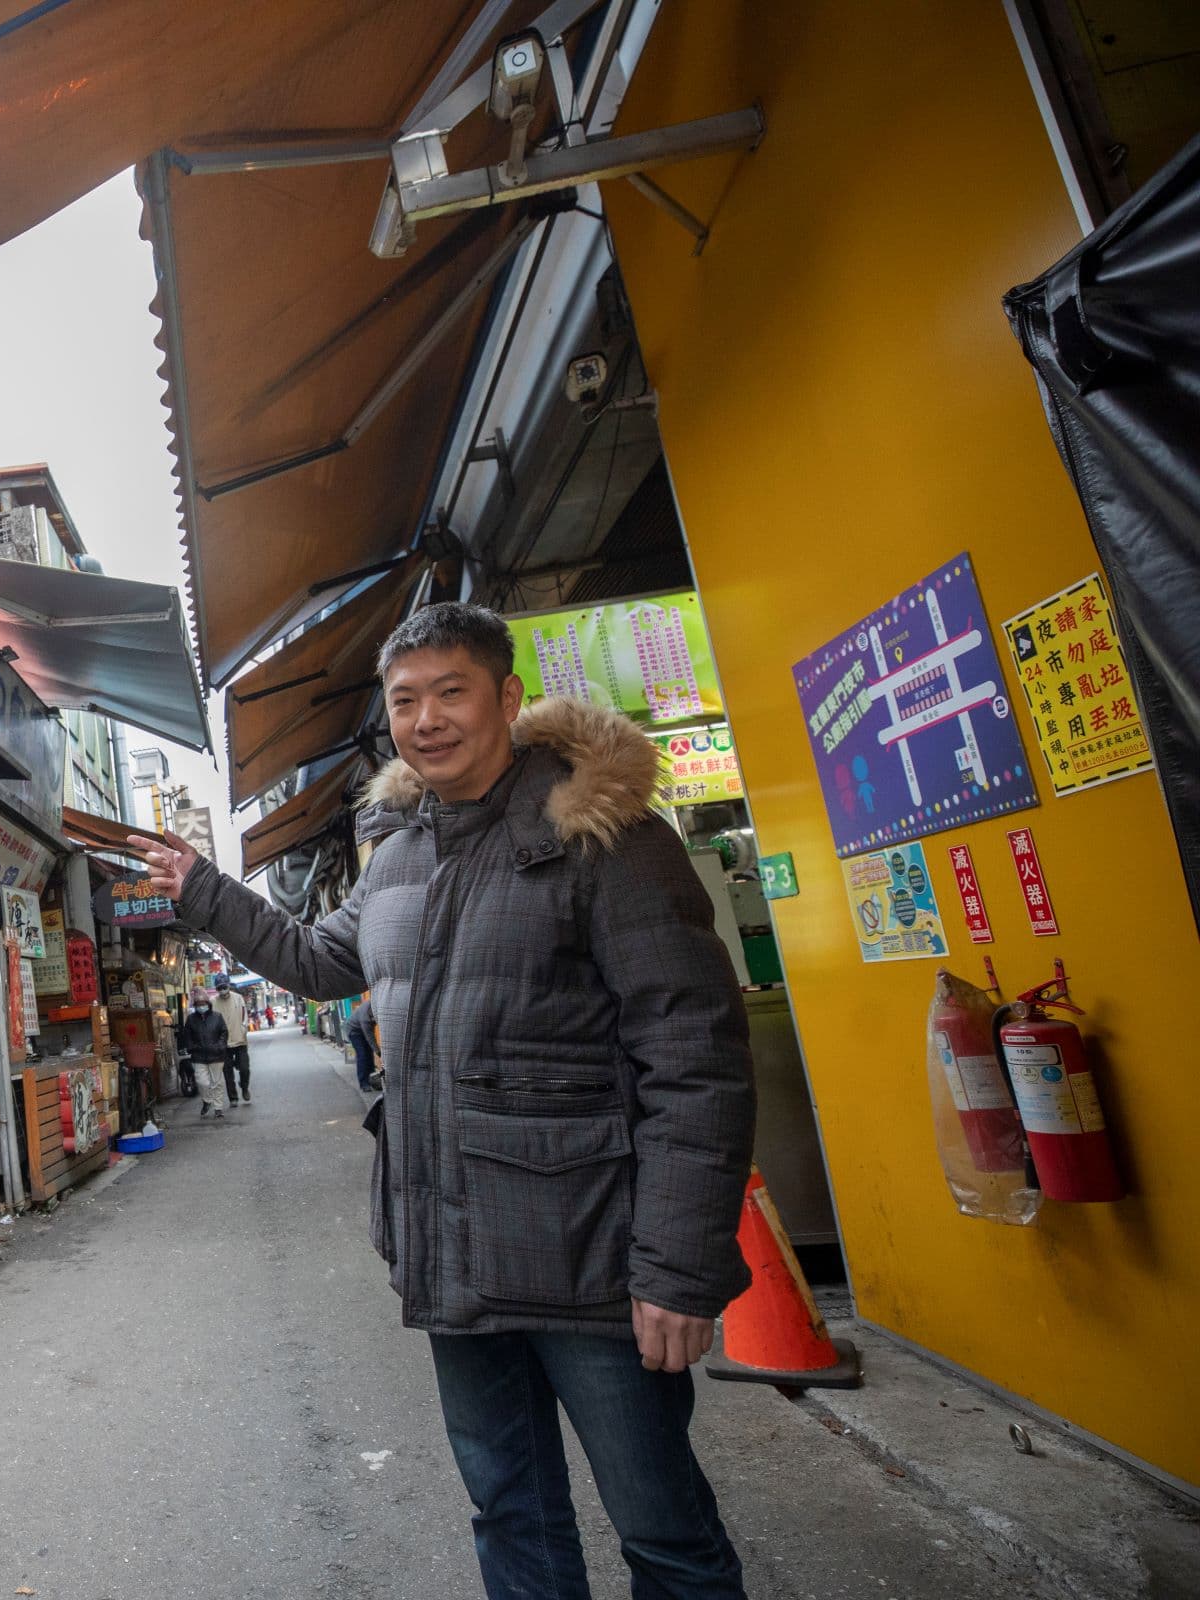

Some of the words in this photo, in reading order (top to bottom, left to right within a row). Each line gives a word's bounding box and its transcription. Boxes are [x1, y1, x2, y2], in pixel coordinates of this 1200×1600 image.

[1036, 618, 1086, 740] 夜市專用
[1054, 606, 1109, 732] 請勿亂丟
[1079, 595, 1136, 721] 家庭垃圾
[673, 756, 737, 777] 楊桃鮮奶
[953, 849, 980, 916] 滅火器
[1013, 833, 1043, 906] 滅火器
[114, 897, 173, 917] 厚切牛
